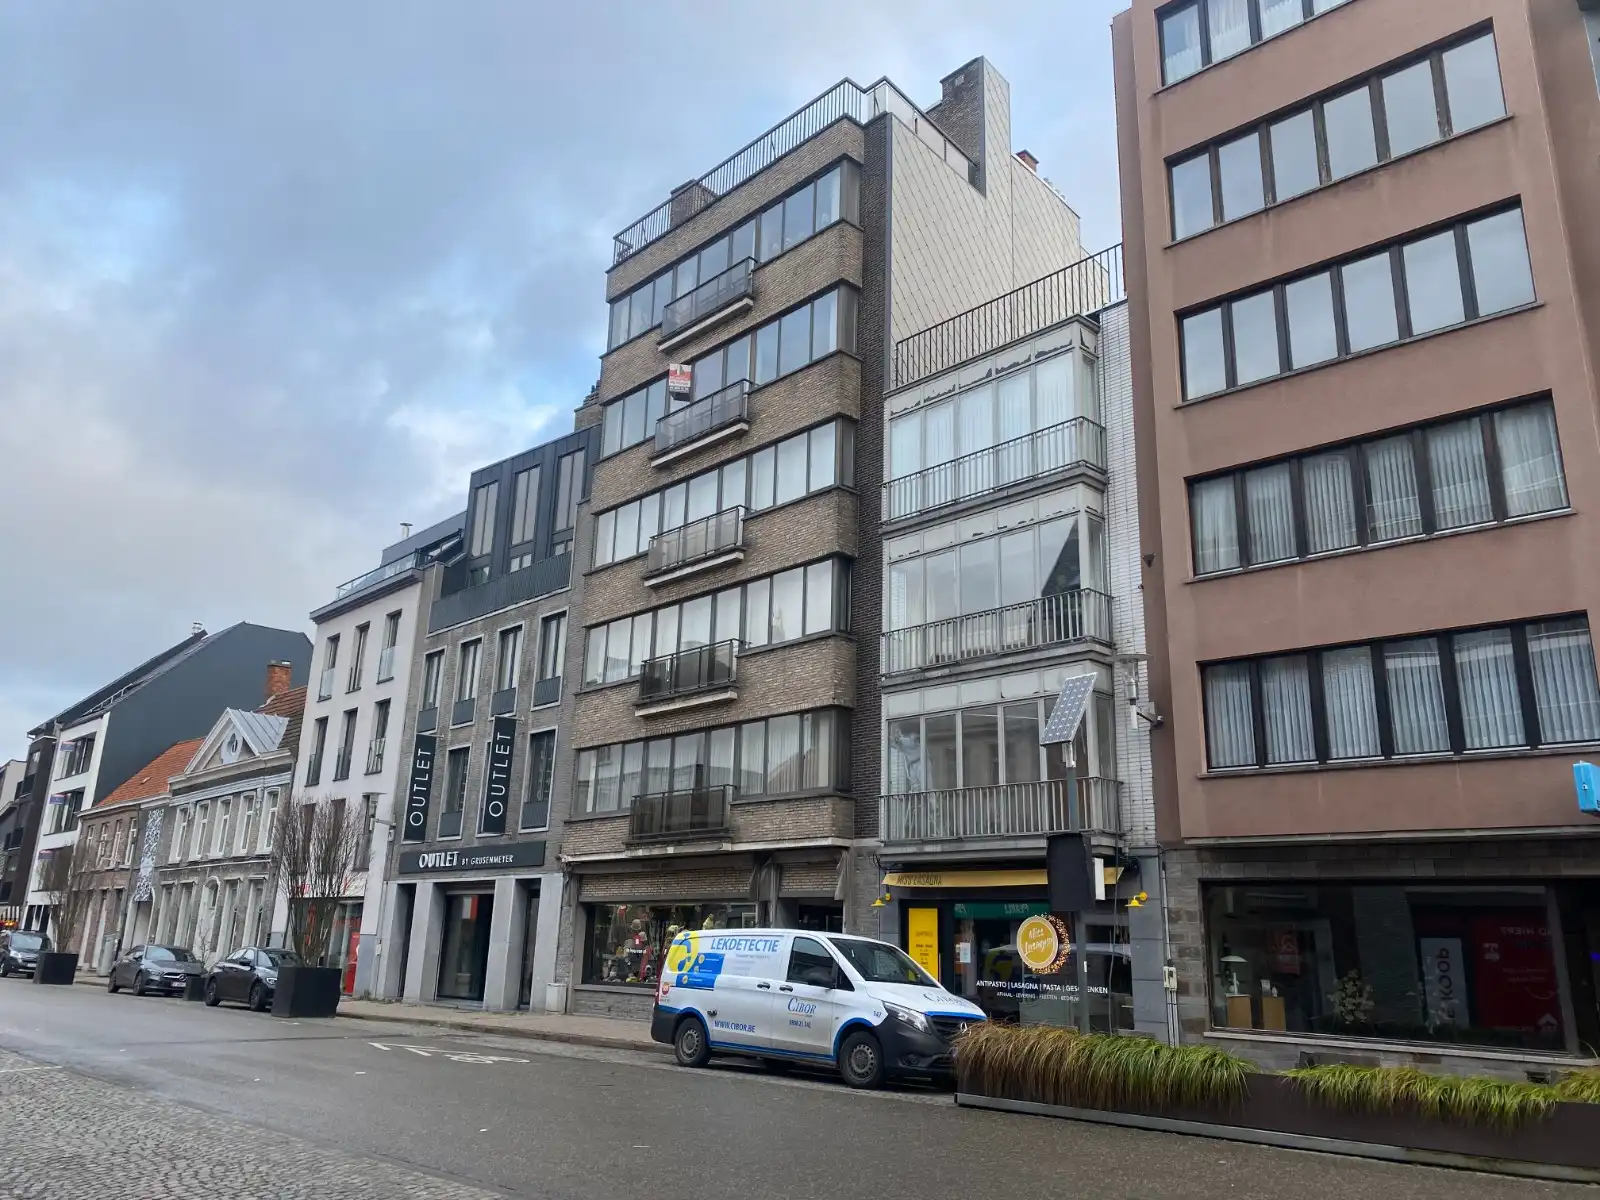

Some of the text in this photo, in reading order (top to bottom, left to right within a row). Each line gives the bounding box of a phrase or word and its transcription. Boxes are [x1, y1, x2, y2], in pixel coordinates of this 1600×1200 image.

[489, 732, 510, 817] OUTLET
[410, 749, 432, 826] OUTLET
[418, 851, 459, 868] OUTLET
[710, 938, 780, 952] LEKDETECTIE
[1066, 985, 1108, 994] GESENKEN
[788, 997, 817, 1014] CIBOR
[715, 1020, 755, 1032] WWW.CIBOR.BE
